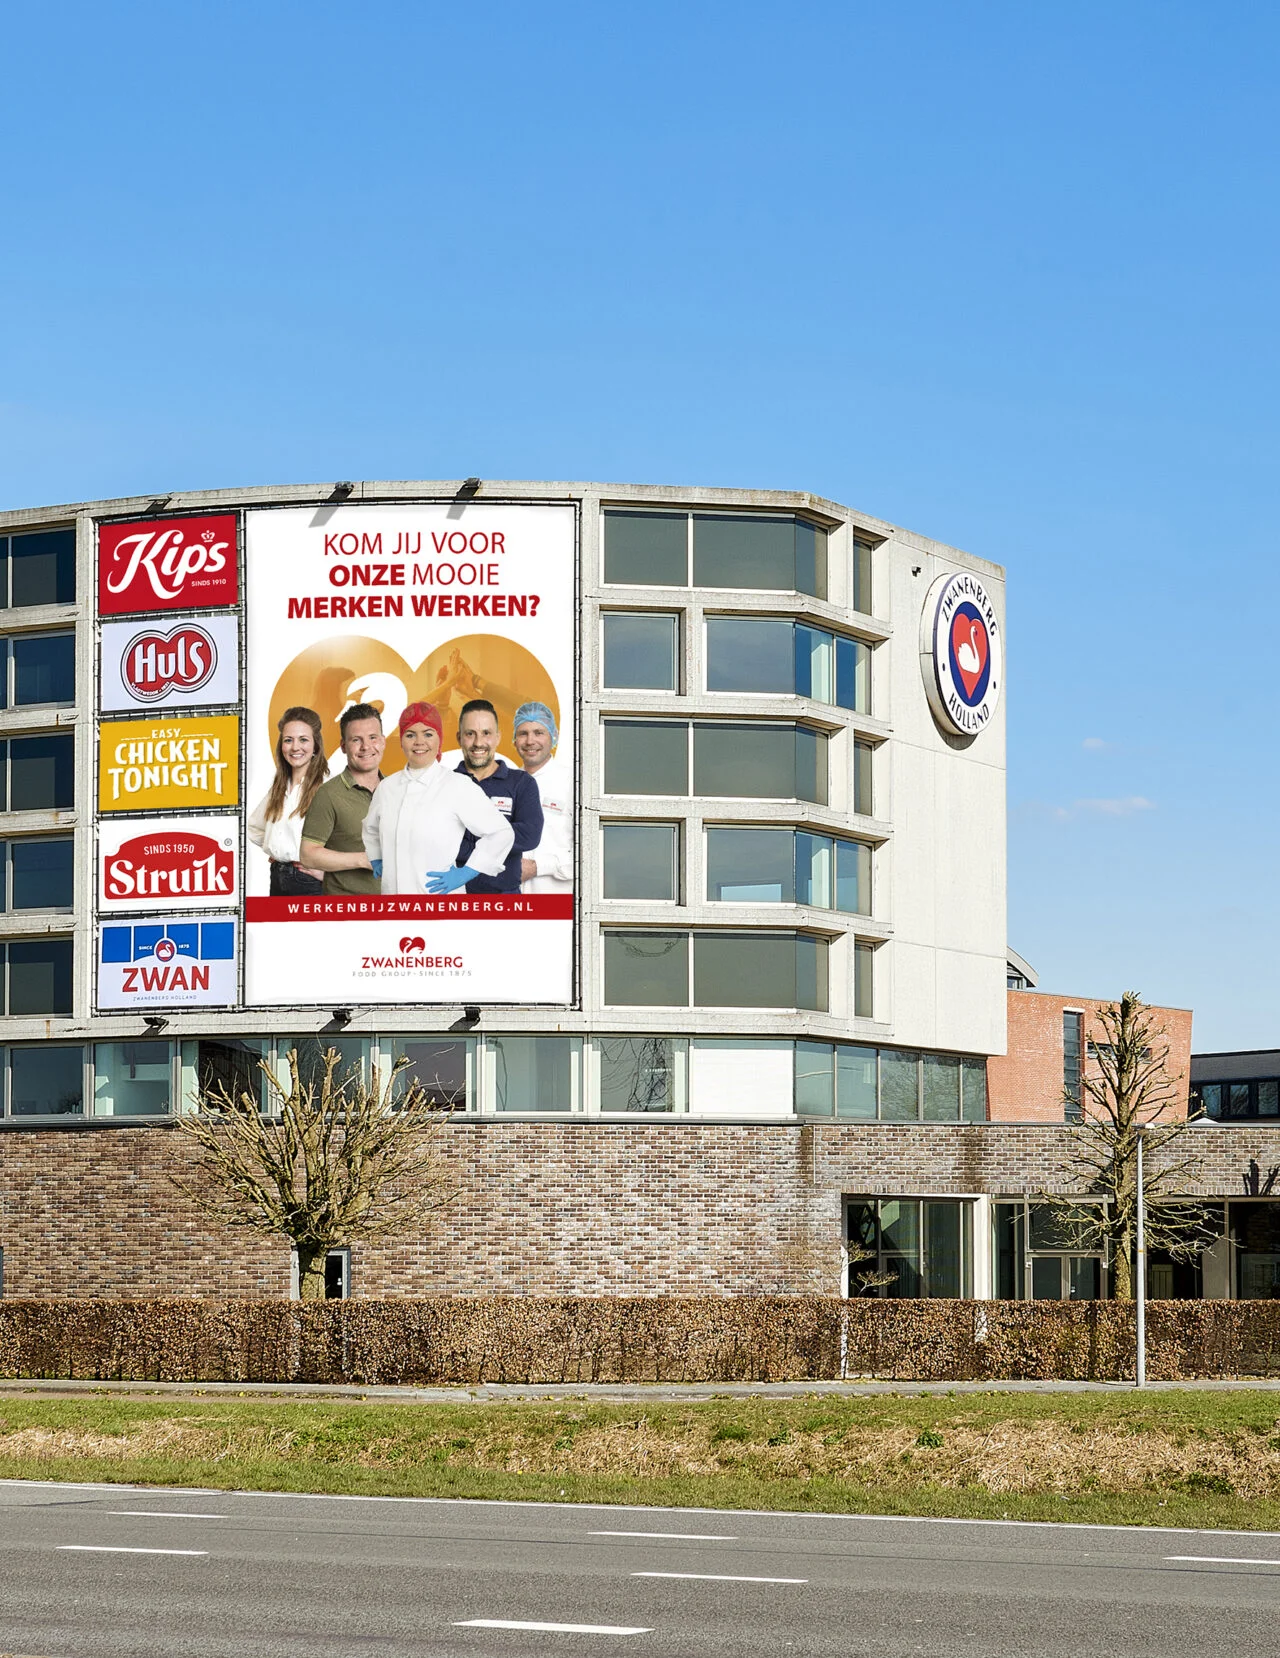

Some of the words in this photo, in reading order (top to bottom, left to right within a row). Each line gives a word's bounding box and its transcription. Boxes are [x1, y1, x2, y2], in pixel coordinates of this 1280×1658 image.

[324, 532, 383, 556] KOM
[392, 532, 421, 554] JIJ
[431, 531, 505, 554] VOOR
[107, 529, 229, 600] Kips
[329, 564, 406, 587] ONZE
[412, 563, 499, 586] MOOIE
[288, 596, 404, 619] MERKEN
[411, 595, 541, 617] WERKEN?
[941, 576, 998, 637] ZWANENBERG
[134, 636, 203, 683] Huls
[948, 692, 990, 730] HOLLAND
[151, 727, 181, 739] EASY
[115, 738, 220, 765] CHICKEN
[108, 763, 228, 801] TONIGHT
[143, 844, 171, 856] SINDS
[173, 843, 195, 854] 1950
[109, 853, 229, 896] Struik
[287, 901, 534, 914] WERKENBIJZWANENBERG.NL
[361, 956, 463, 969] ZWANENBERG
[122, 965, 210, 992] ZWAN
